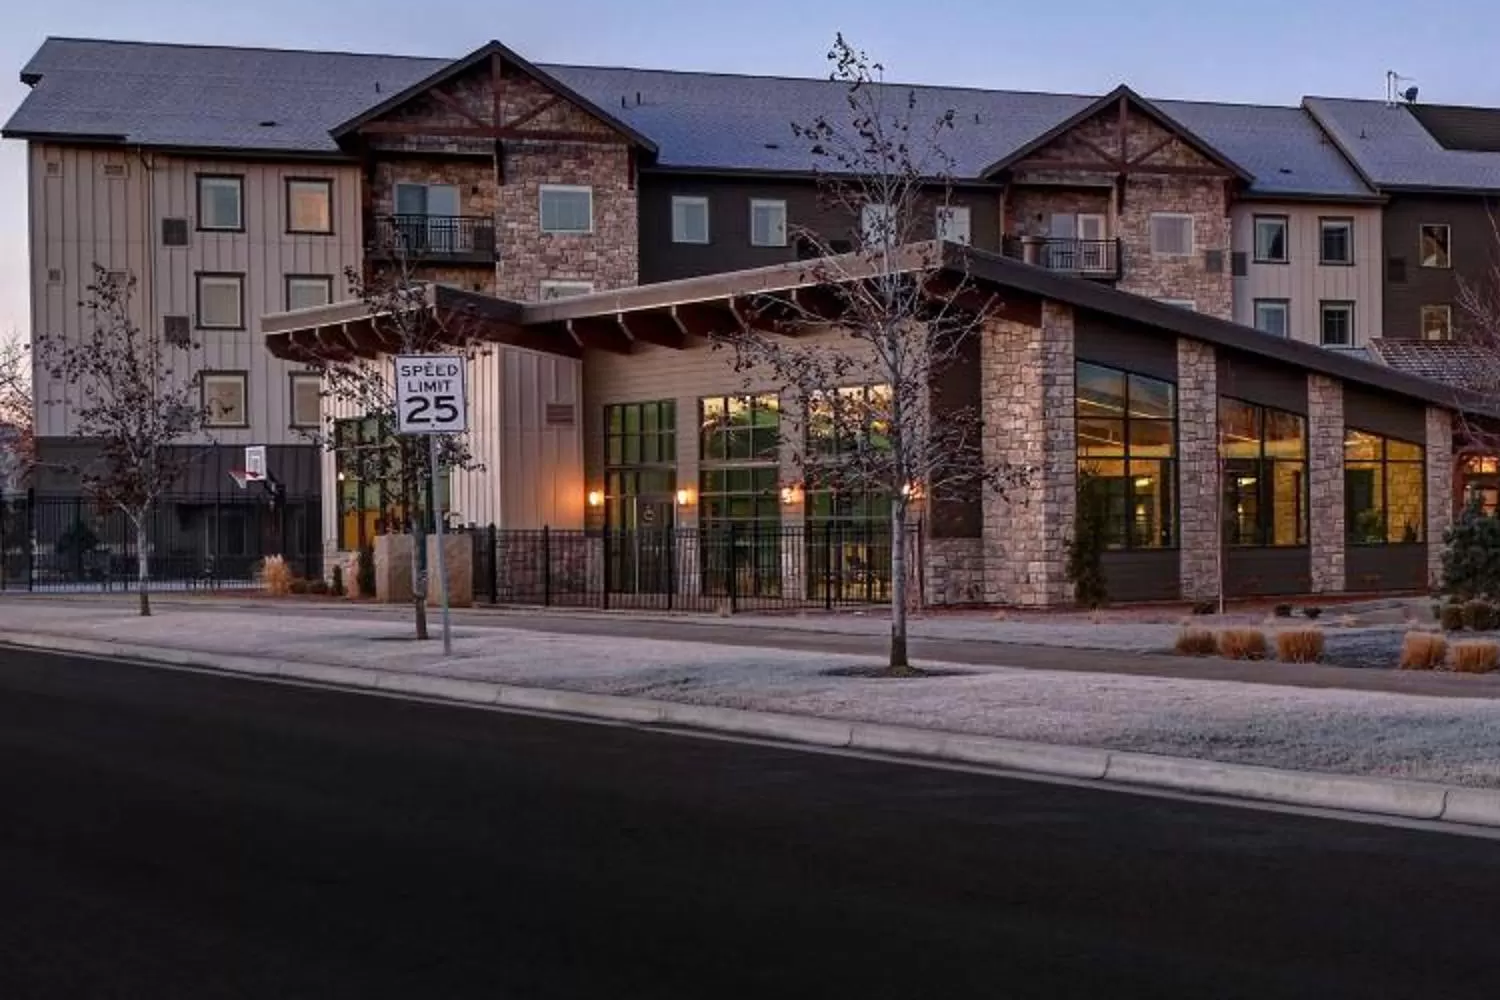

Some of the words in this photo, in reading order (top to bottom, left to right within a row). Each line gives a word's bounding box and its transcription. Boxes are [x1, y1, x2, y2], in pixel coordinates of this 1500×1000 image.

[401, 364, 459, 377] SPEED
[408, 381, 453, 393] LIMIT
[405, 395, 459, 424] 25
